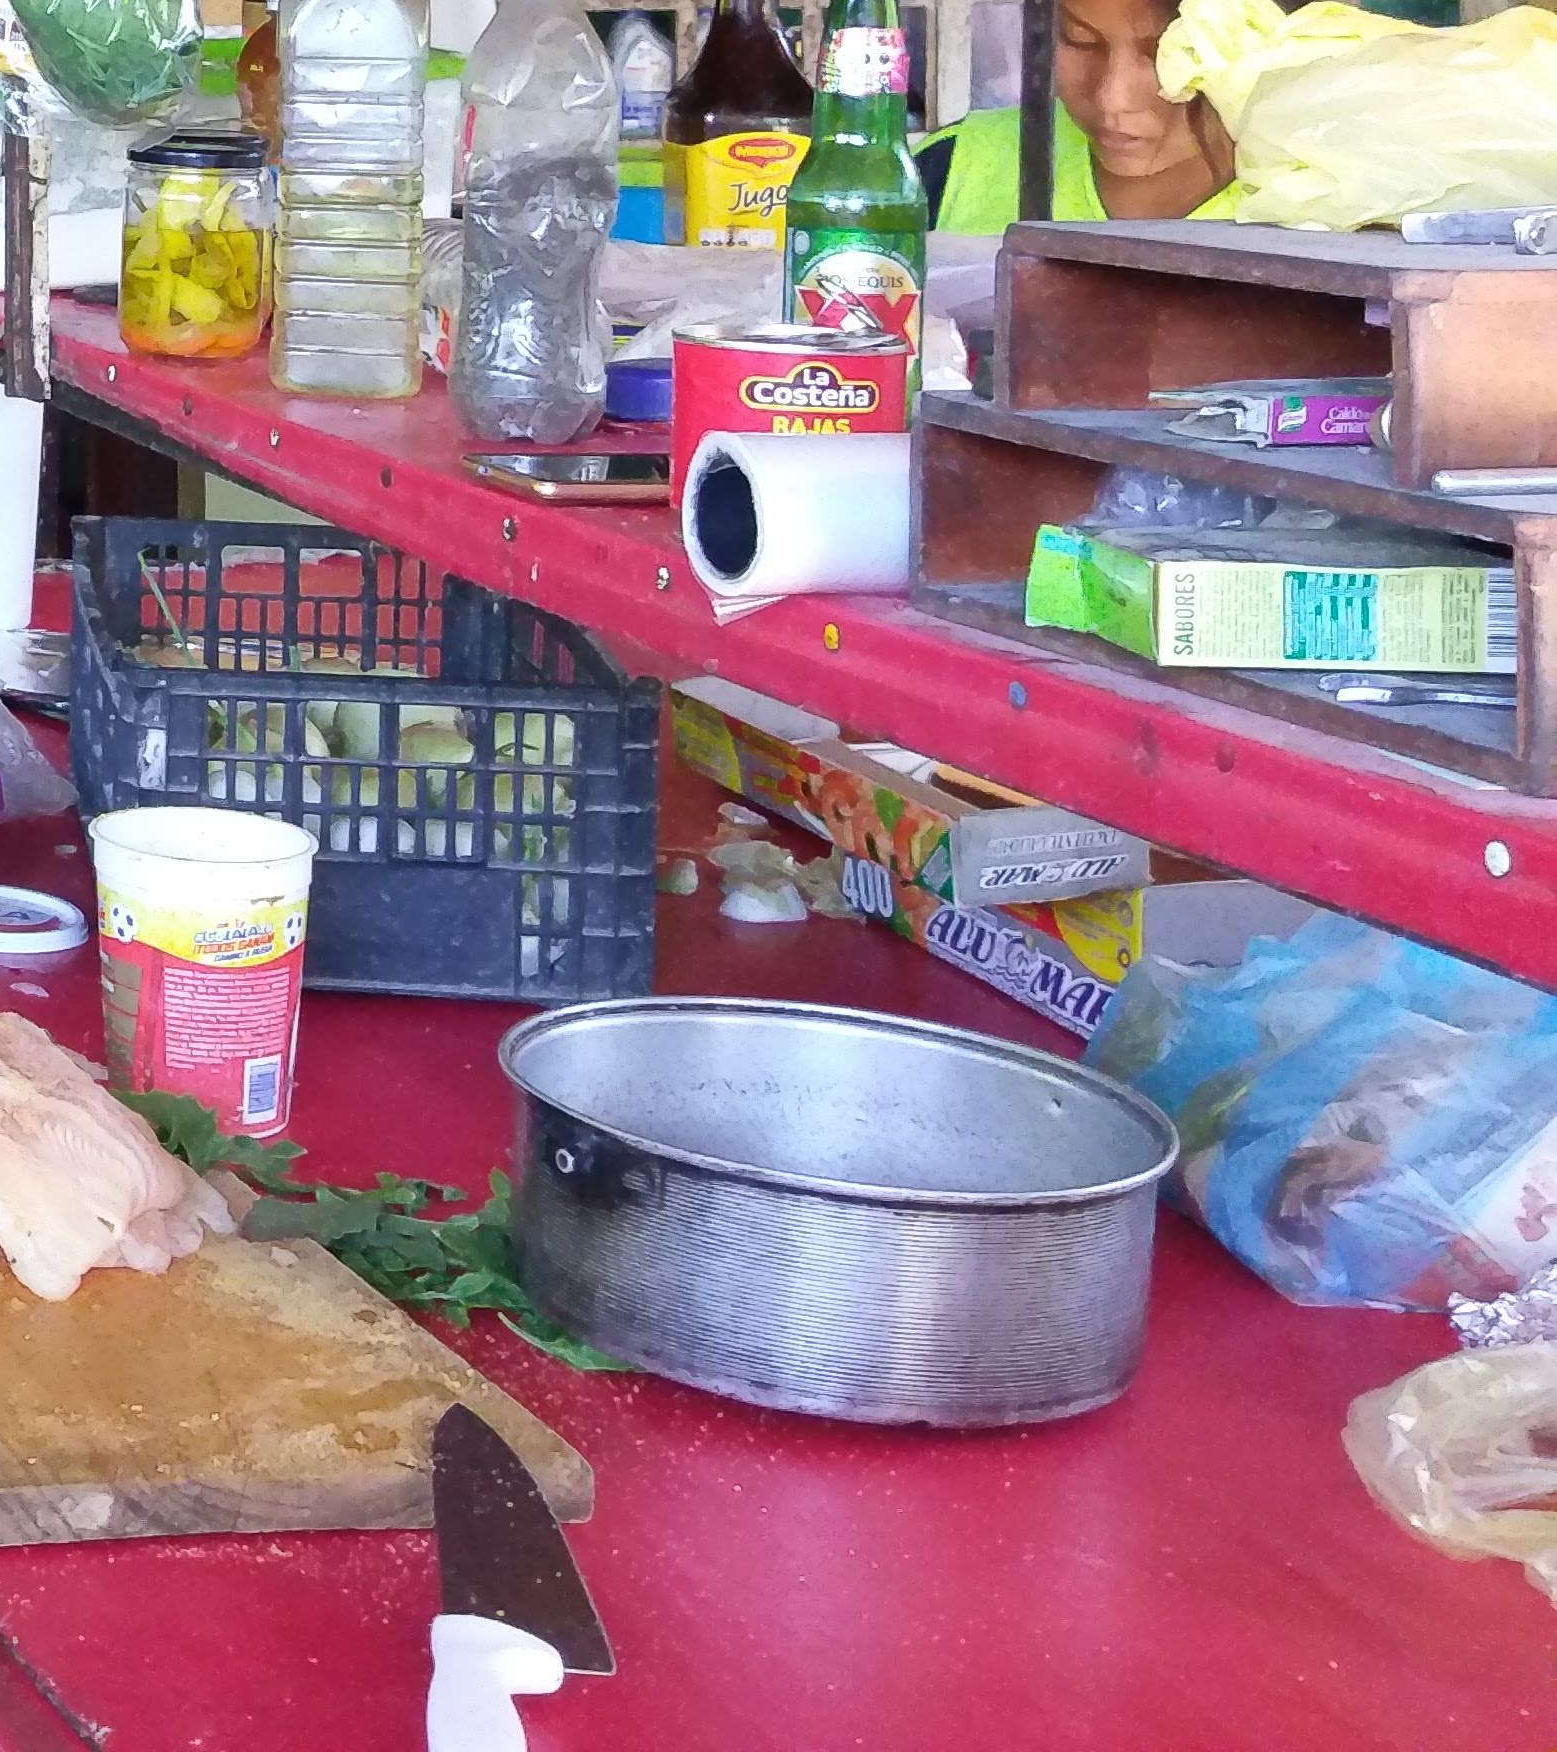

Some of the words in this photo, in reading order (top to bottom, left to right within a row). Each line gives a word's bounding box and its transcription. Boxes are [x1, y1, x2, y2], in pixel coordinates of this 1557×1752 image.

[858, 276, 904, 288] EQUIS
[803, 368, 830, 386] La
[753, 382, 870, 407] Costeña
[772, 415, 852, 435] RAJAS
[1173, 572, 1195, 656] SABORES
[841, 854, 893, 918] 400
[927, 908, 997, 964] ALU
